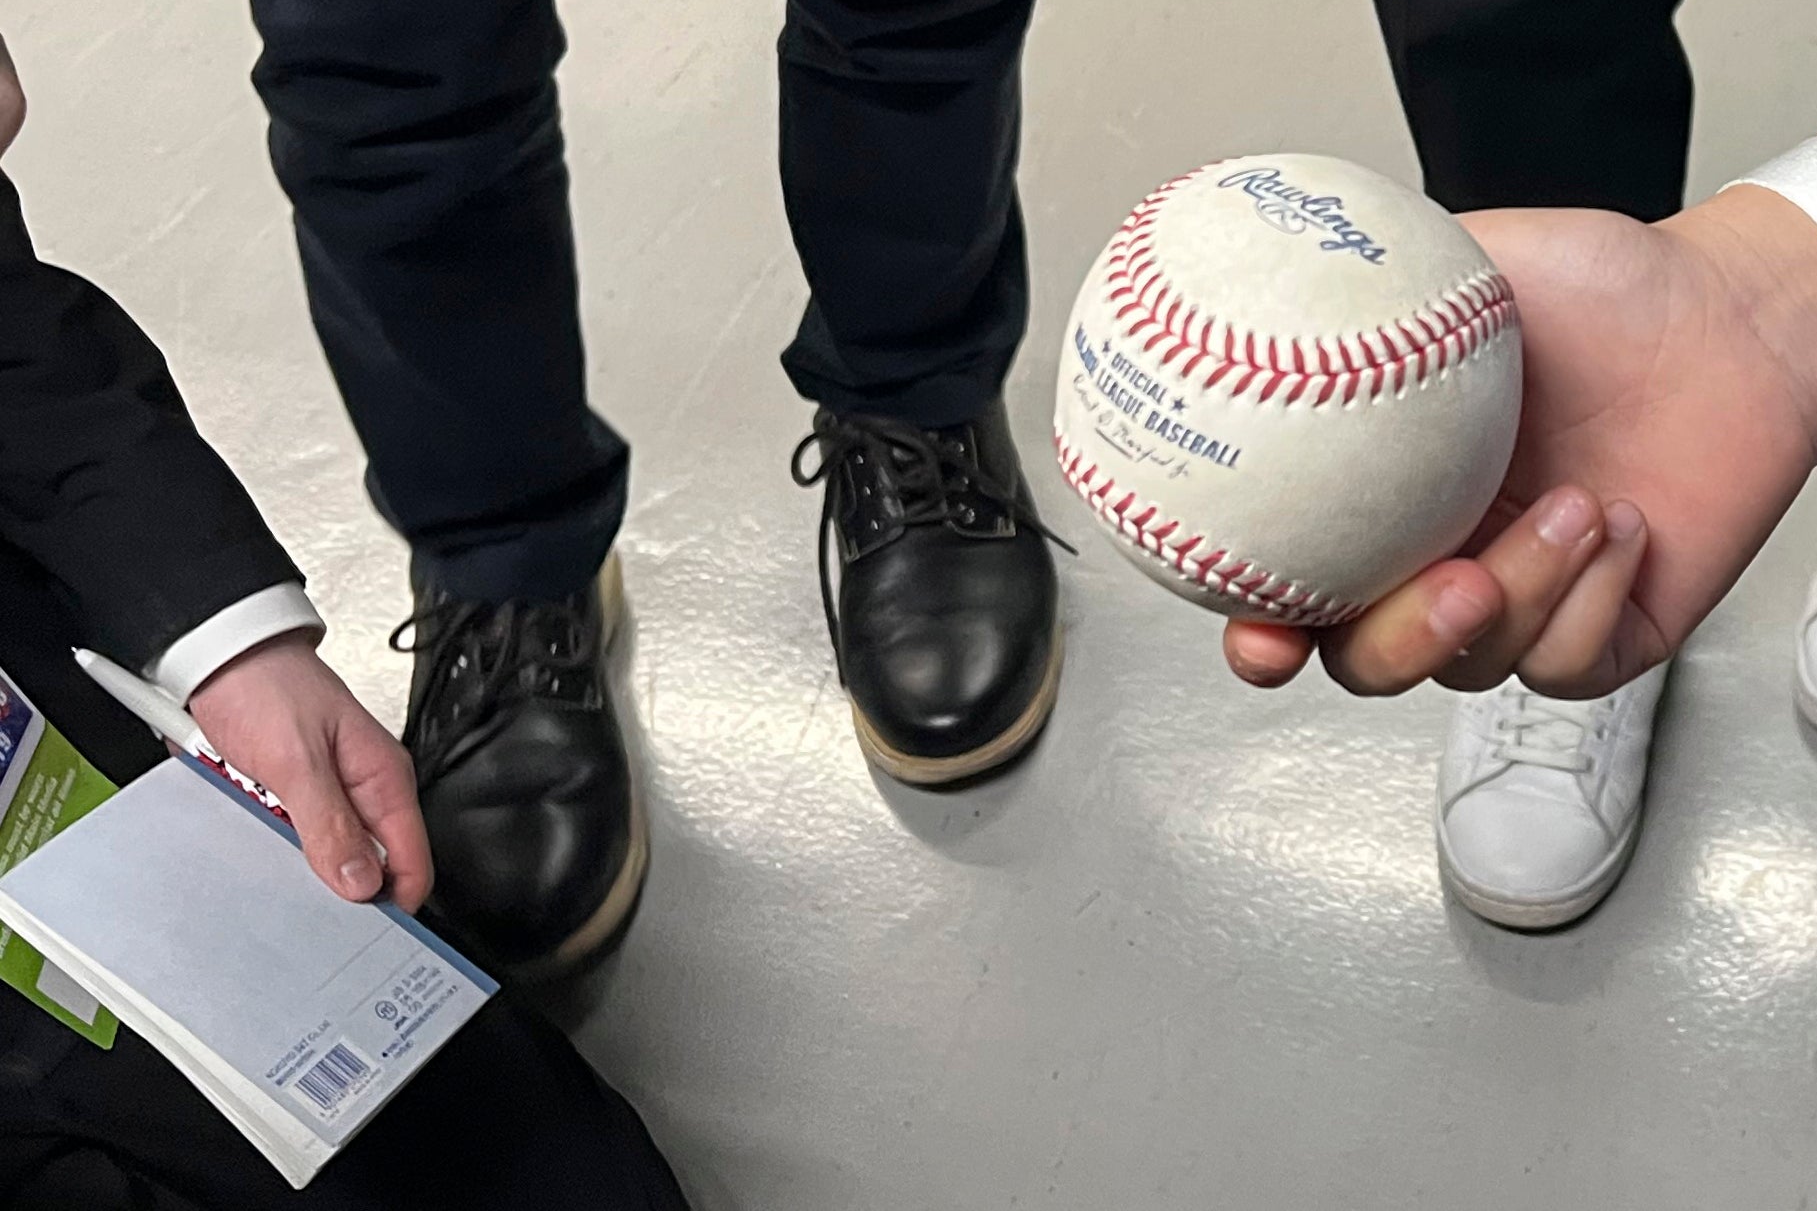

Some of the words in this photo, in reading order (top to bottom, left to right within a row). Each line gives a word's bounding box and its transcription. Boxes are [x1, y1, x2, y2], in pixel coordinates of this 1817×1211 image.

[1218, 168, 1387, 265] Rawlings
[1096, 368, 1147, 424] LEAGUE
[1144, 410, 1242, 469] BASEBALL
[1111, 352, 1169, 405] OFFICIAL
